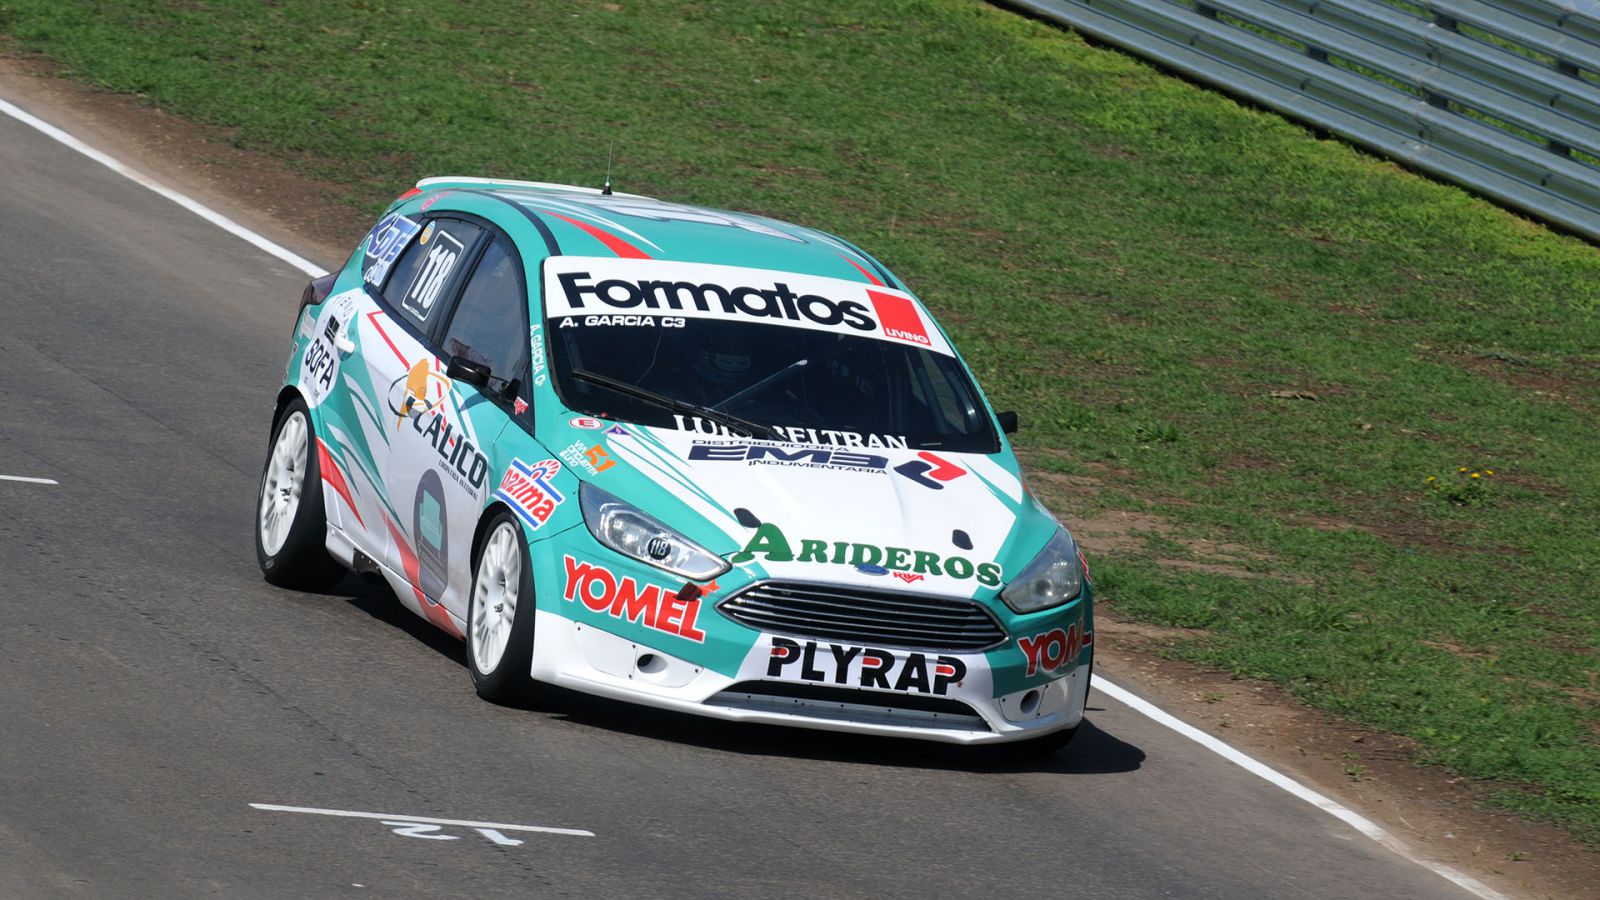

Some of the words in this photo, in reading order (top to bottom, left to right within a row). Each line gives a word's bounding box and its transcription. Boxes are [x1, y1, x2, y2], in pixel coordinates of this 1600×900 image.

[411, 244, 456, 309] 118
[557, 272, 878, 332] Formatos
[559, 316, 579, 329] A.
[585, 315, 656, 327] GARCIA
[661, 316, 686, 329] C3
[885, 327, 929, 344] LIVING
[304, 338, 337, 391] SOFA
[413, 413, 489, 490] CALICO
[583, 444, 618, 473] 51
[691, 439, 850, 453] DISTRIBUIDORA
[748, 460, 888, 475] INDUMENTARIA
[650, 539, 668, 556] 118
[731, 523, 1003, 588] ARIDEROS
[564, 556, 706, 643] YOMEL
[767, 637, 967, 696] PLYRAP
